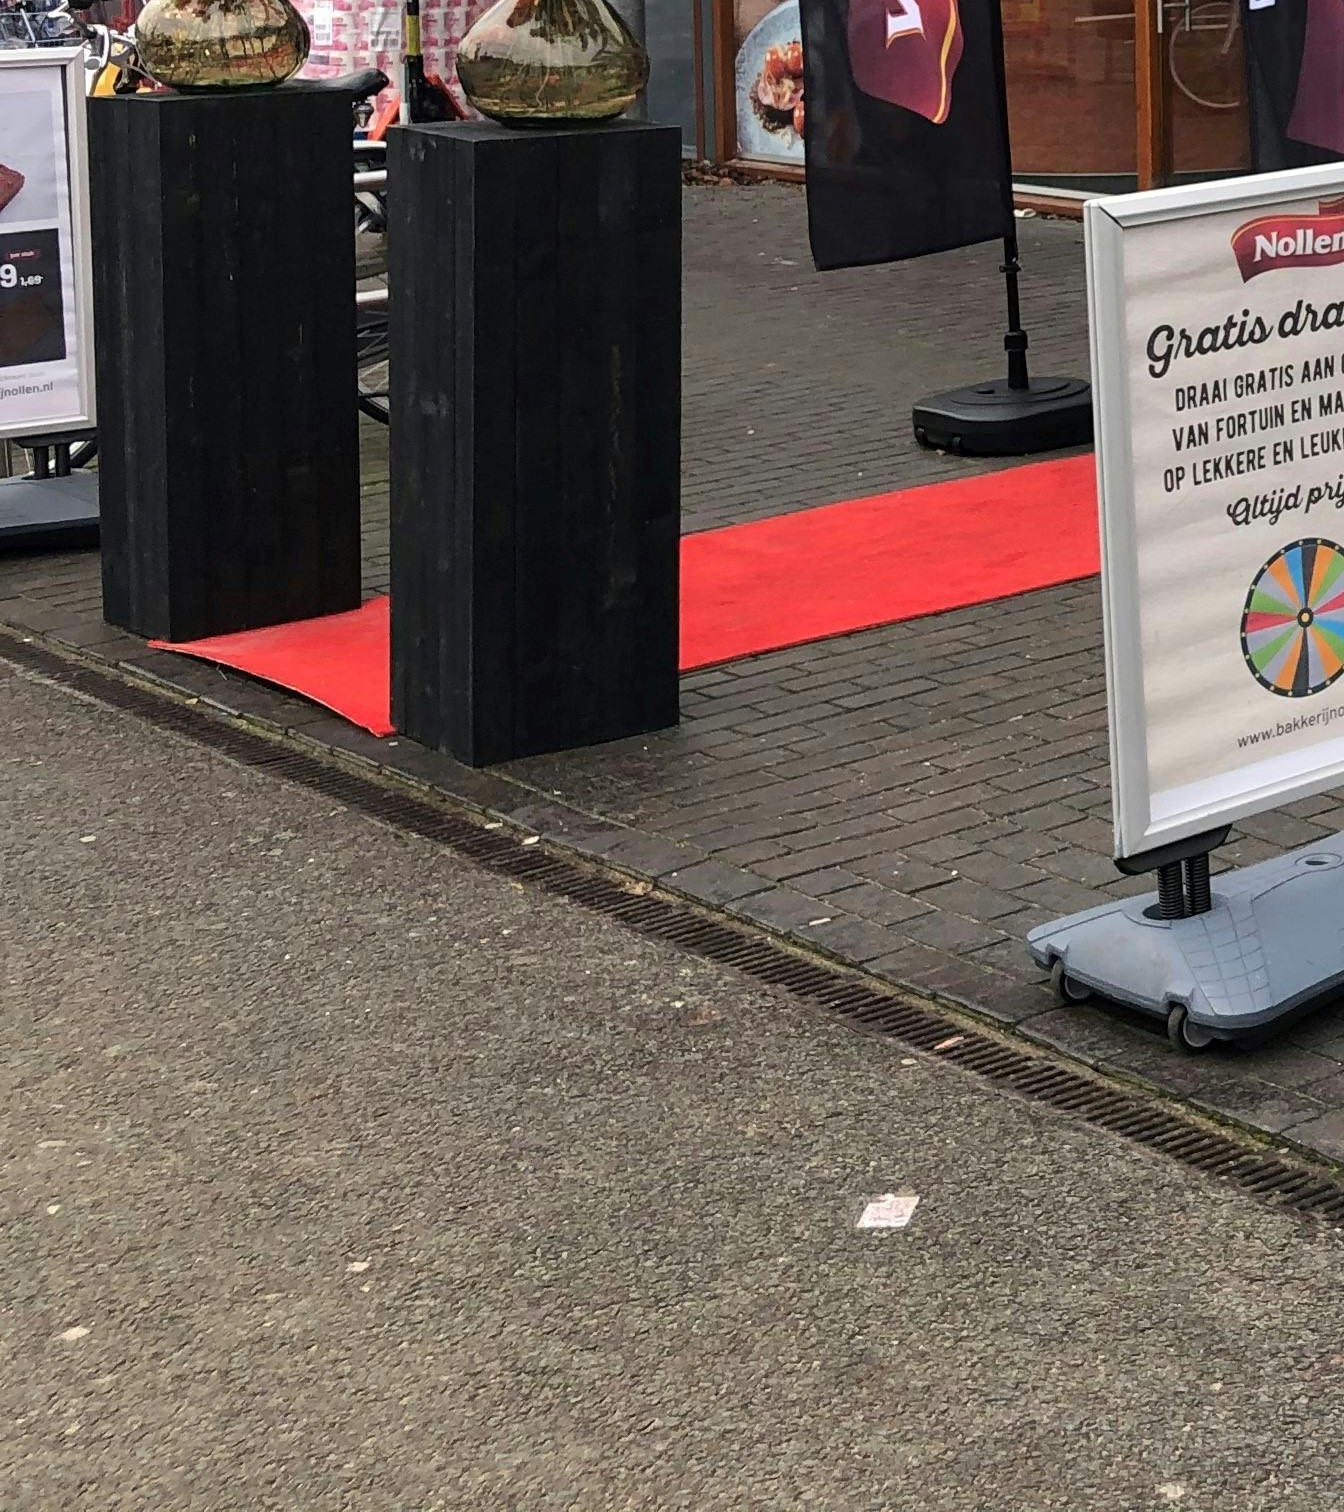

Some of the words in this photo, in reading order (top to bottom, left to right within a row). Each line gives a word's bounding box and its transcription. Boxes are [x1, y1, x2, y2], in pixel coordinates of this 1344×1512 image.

[1147, 309, 1274, 379] Gratis
[0, 381, 54, 399] jnollen.nl
[1175, 378, 1228, 412] DRAAI
[1234, 364, 1295, 399] GRATIS
[1301, 355, 1335, 384] AAN
[1172, 421, 1210, 451] VAN
[1216, 404, 1285, 442] FORTUIN
[1291, 397, 1312, 423] EN
[1163, 466, 1186, 492] OP
[1192, 446, 1267, 487] LEKKERE
[1273, 438, 1294, 466] EN
[1227, 485, 1303, 526] Altijd
